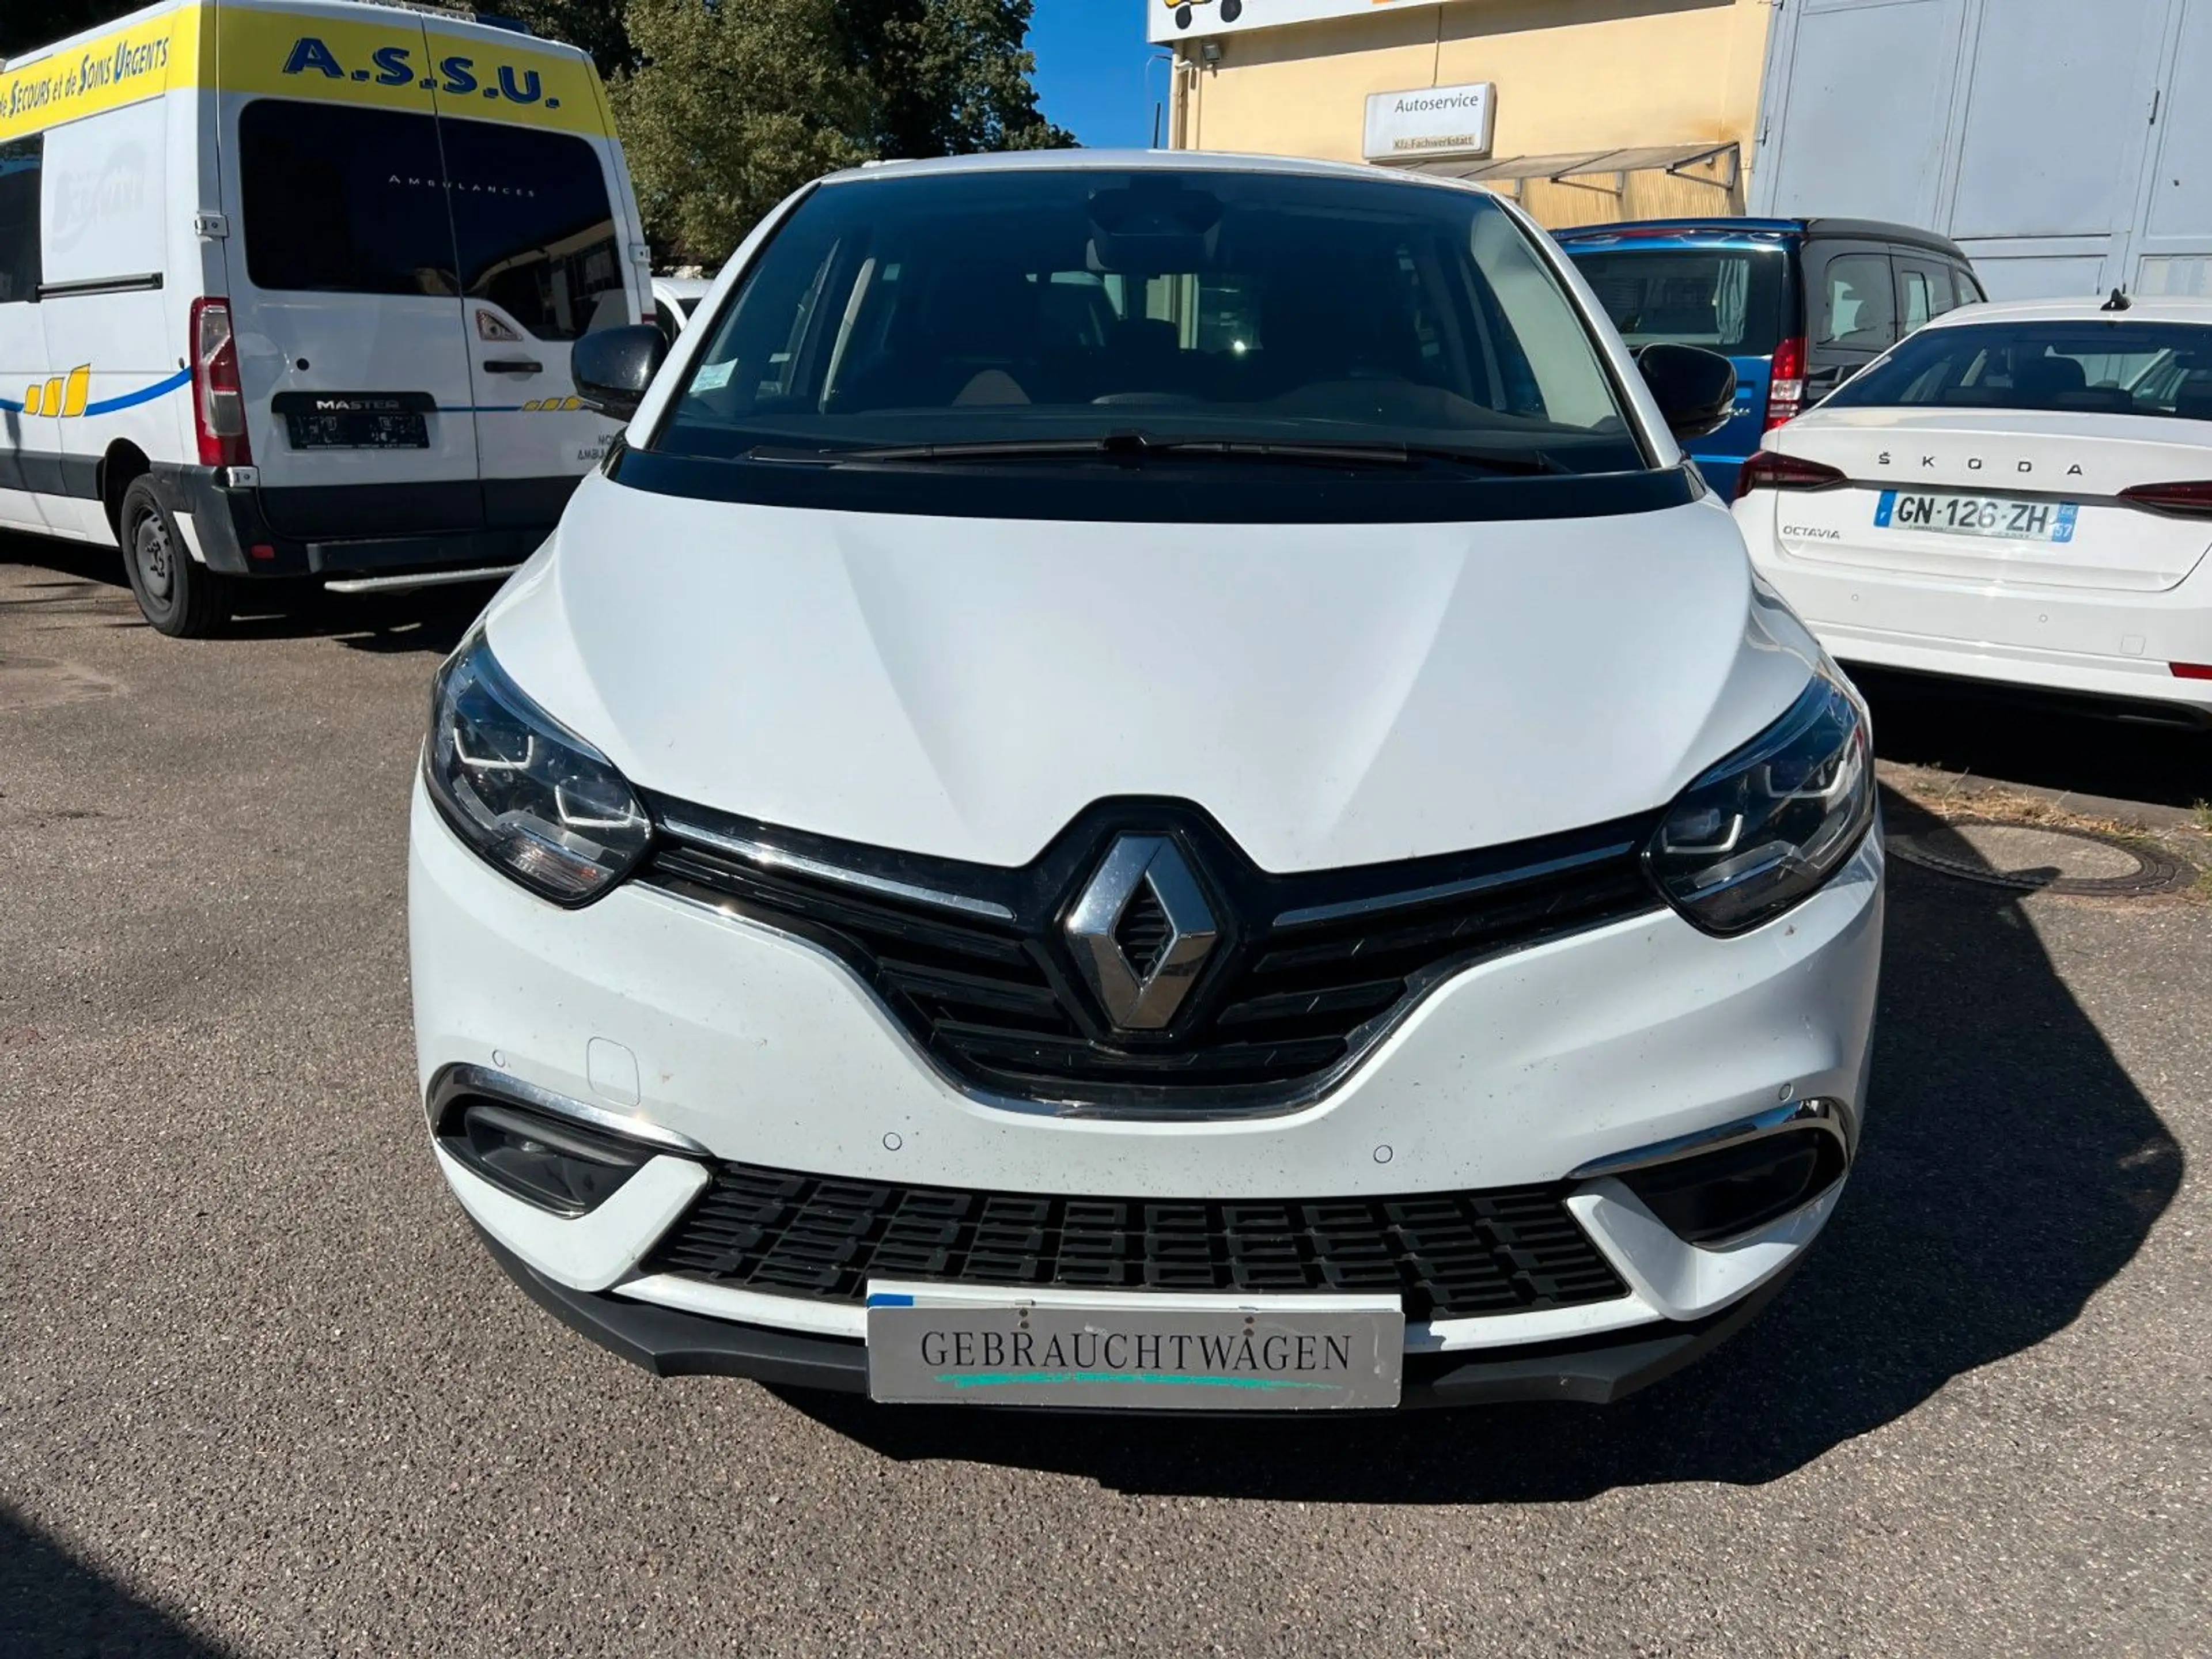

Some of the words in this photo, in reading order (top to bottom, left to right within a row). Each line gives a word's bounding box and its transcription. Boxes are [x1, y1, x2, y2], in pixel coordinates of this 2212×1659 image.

[9, 78, 51, 118] SECOURS
[53, 74, 63, 101] et
[65, 69, 76, 98] de
[78, 54, 112, 96] SOINS
[113, 37, 169, 84] URGENTS
[283, 37, 560, 109] A.S.S.U.
[1395, 93, 1479, 113] Autoservice
[1393, 135, 1475, 149] Kfz-Fachwerkstatt
[389, 175, 535, 198] AMBULANCES
[316, 400, 400, 410] MASTER
[1878, 451, 2083, 476] ŠKODA
[1897, 496, 2050, 533] GN-126-ZH
[1783, 525, 1840, 539] OCTAVIA
[2054, 522, 2073, 537] 57
[921, 1330, 1353, 1371] GEBRAUCHTWAGEN
